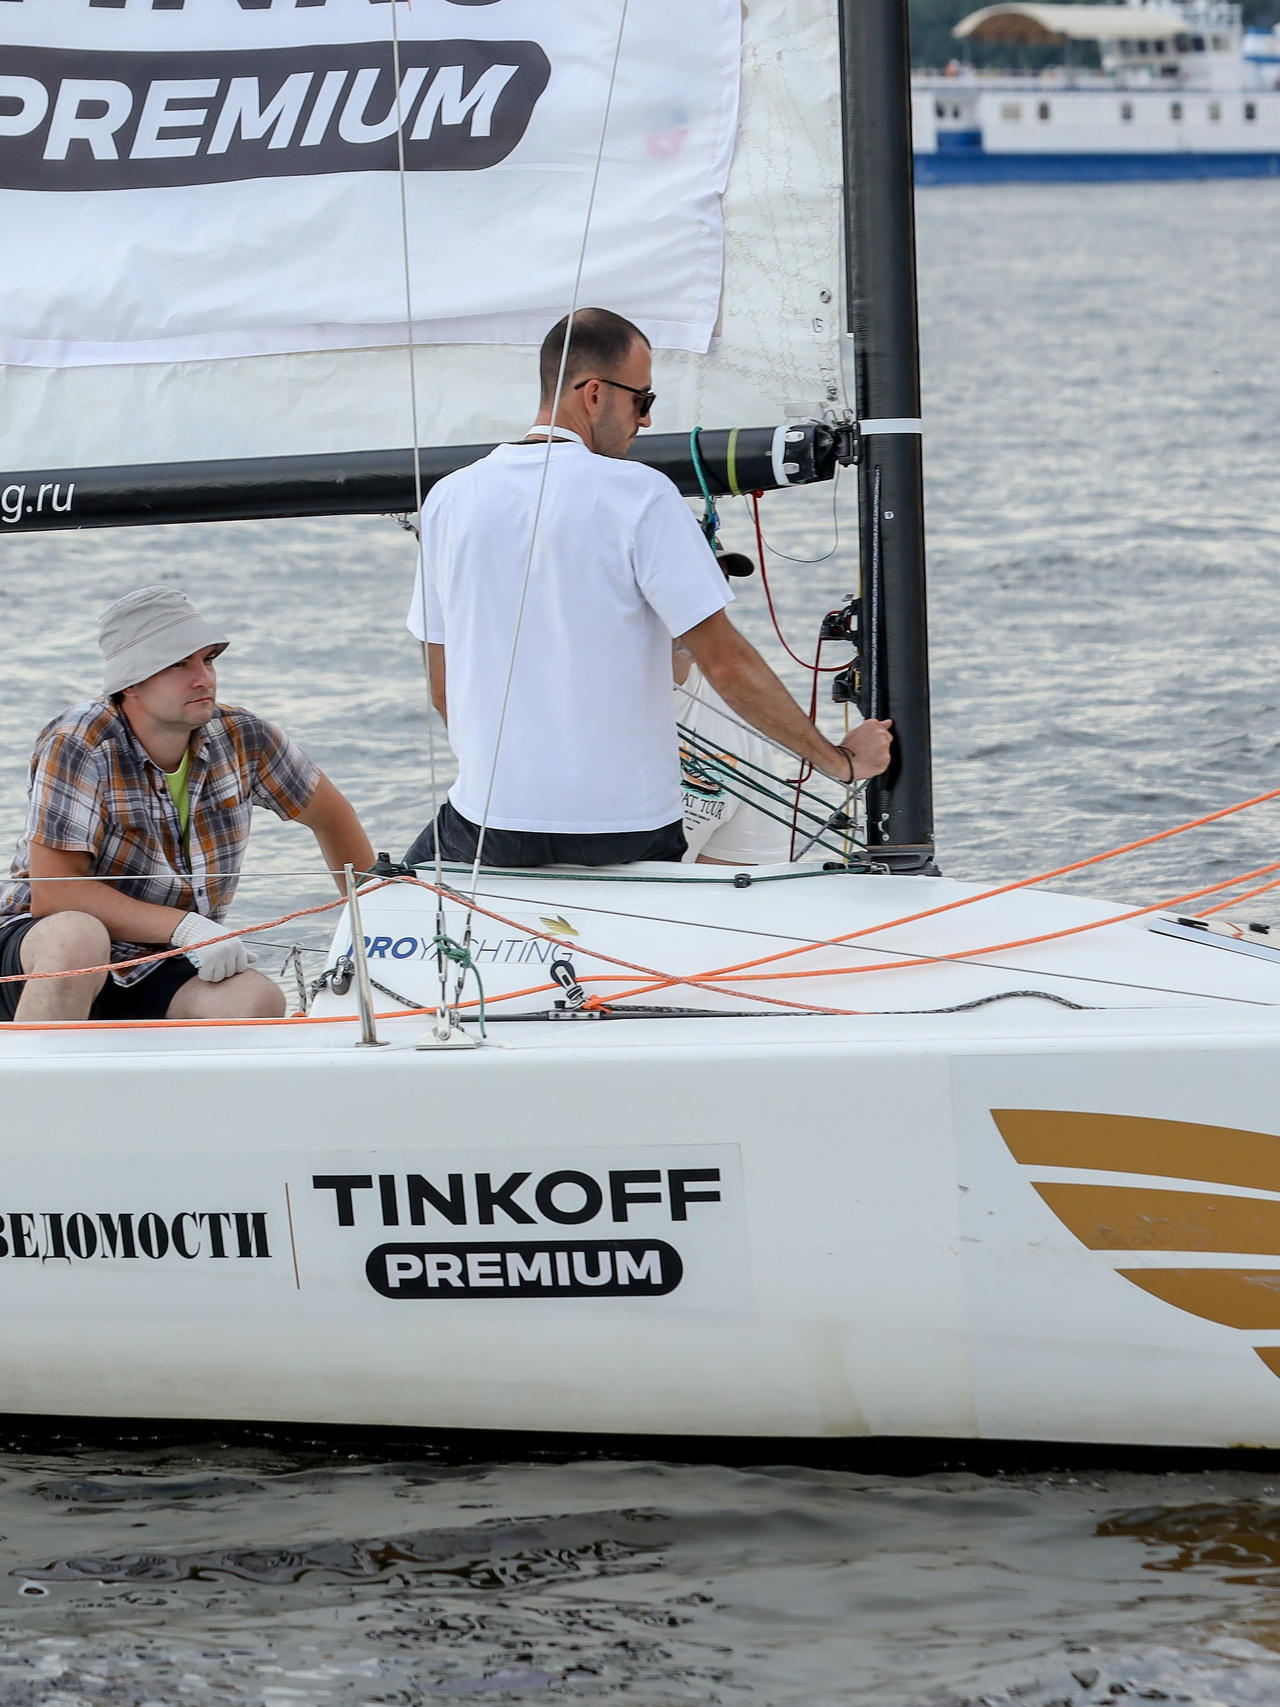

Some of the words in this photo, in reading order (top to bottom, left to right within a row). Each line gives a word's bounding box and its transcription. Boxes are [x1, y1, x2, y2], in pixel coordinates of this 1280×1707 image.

[700, 799, 726, 820] TOUR
[312, 1168, 721, 1227] TINKOFF
[385, 1250, 663, 1288] PREMIUM
